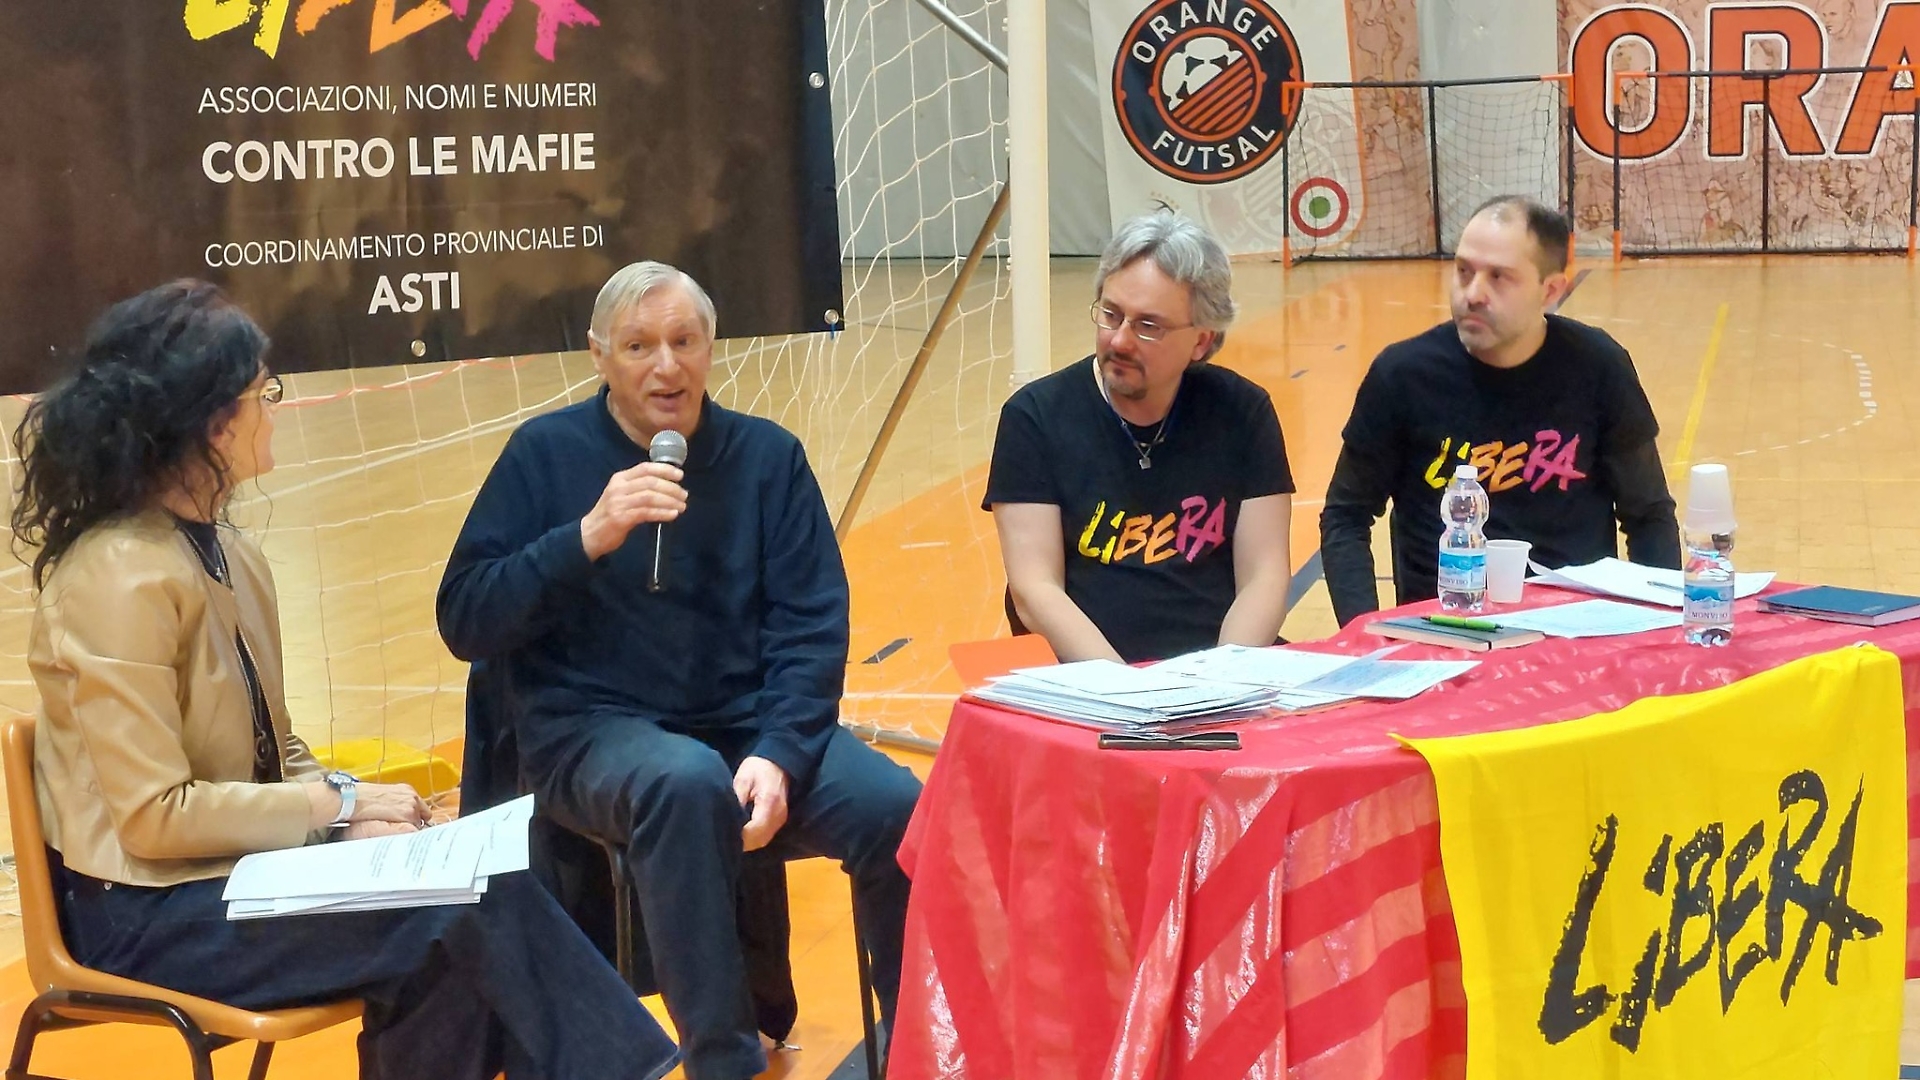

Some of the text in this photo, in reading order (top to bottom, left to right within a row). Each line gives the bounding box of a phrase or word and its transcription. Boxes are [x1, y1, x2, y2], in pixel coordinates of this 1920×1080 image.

[1132, 0, 1278, 64] ORANGE
[198, 82, 597, 115] ASSOCIAZIONI, NOMI E NUMERI
[1568, 1, 1920, 164] ORA
[201, 133, 596, 183] CONTRO LE MAFIE
[1152, 125, 1276, 170] FUTSAL
[205, 224, 603, 268] COORDINAMENTO PROVINCIALE DI
[368, 271, 461, 315] ASTI
